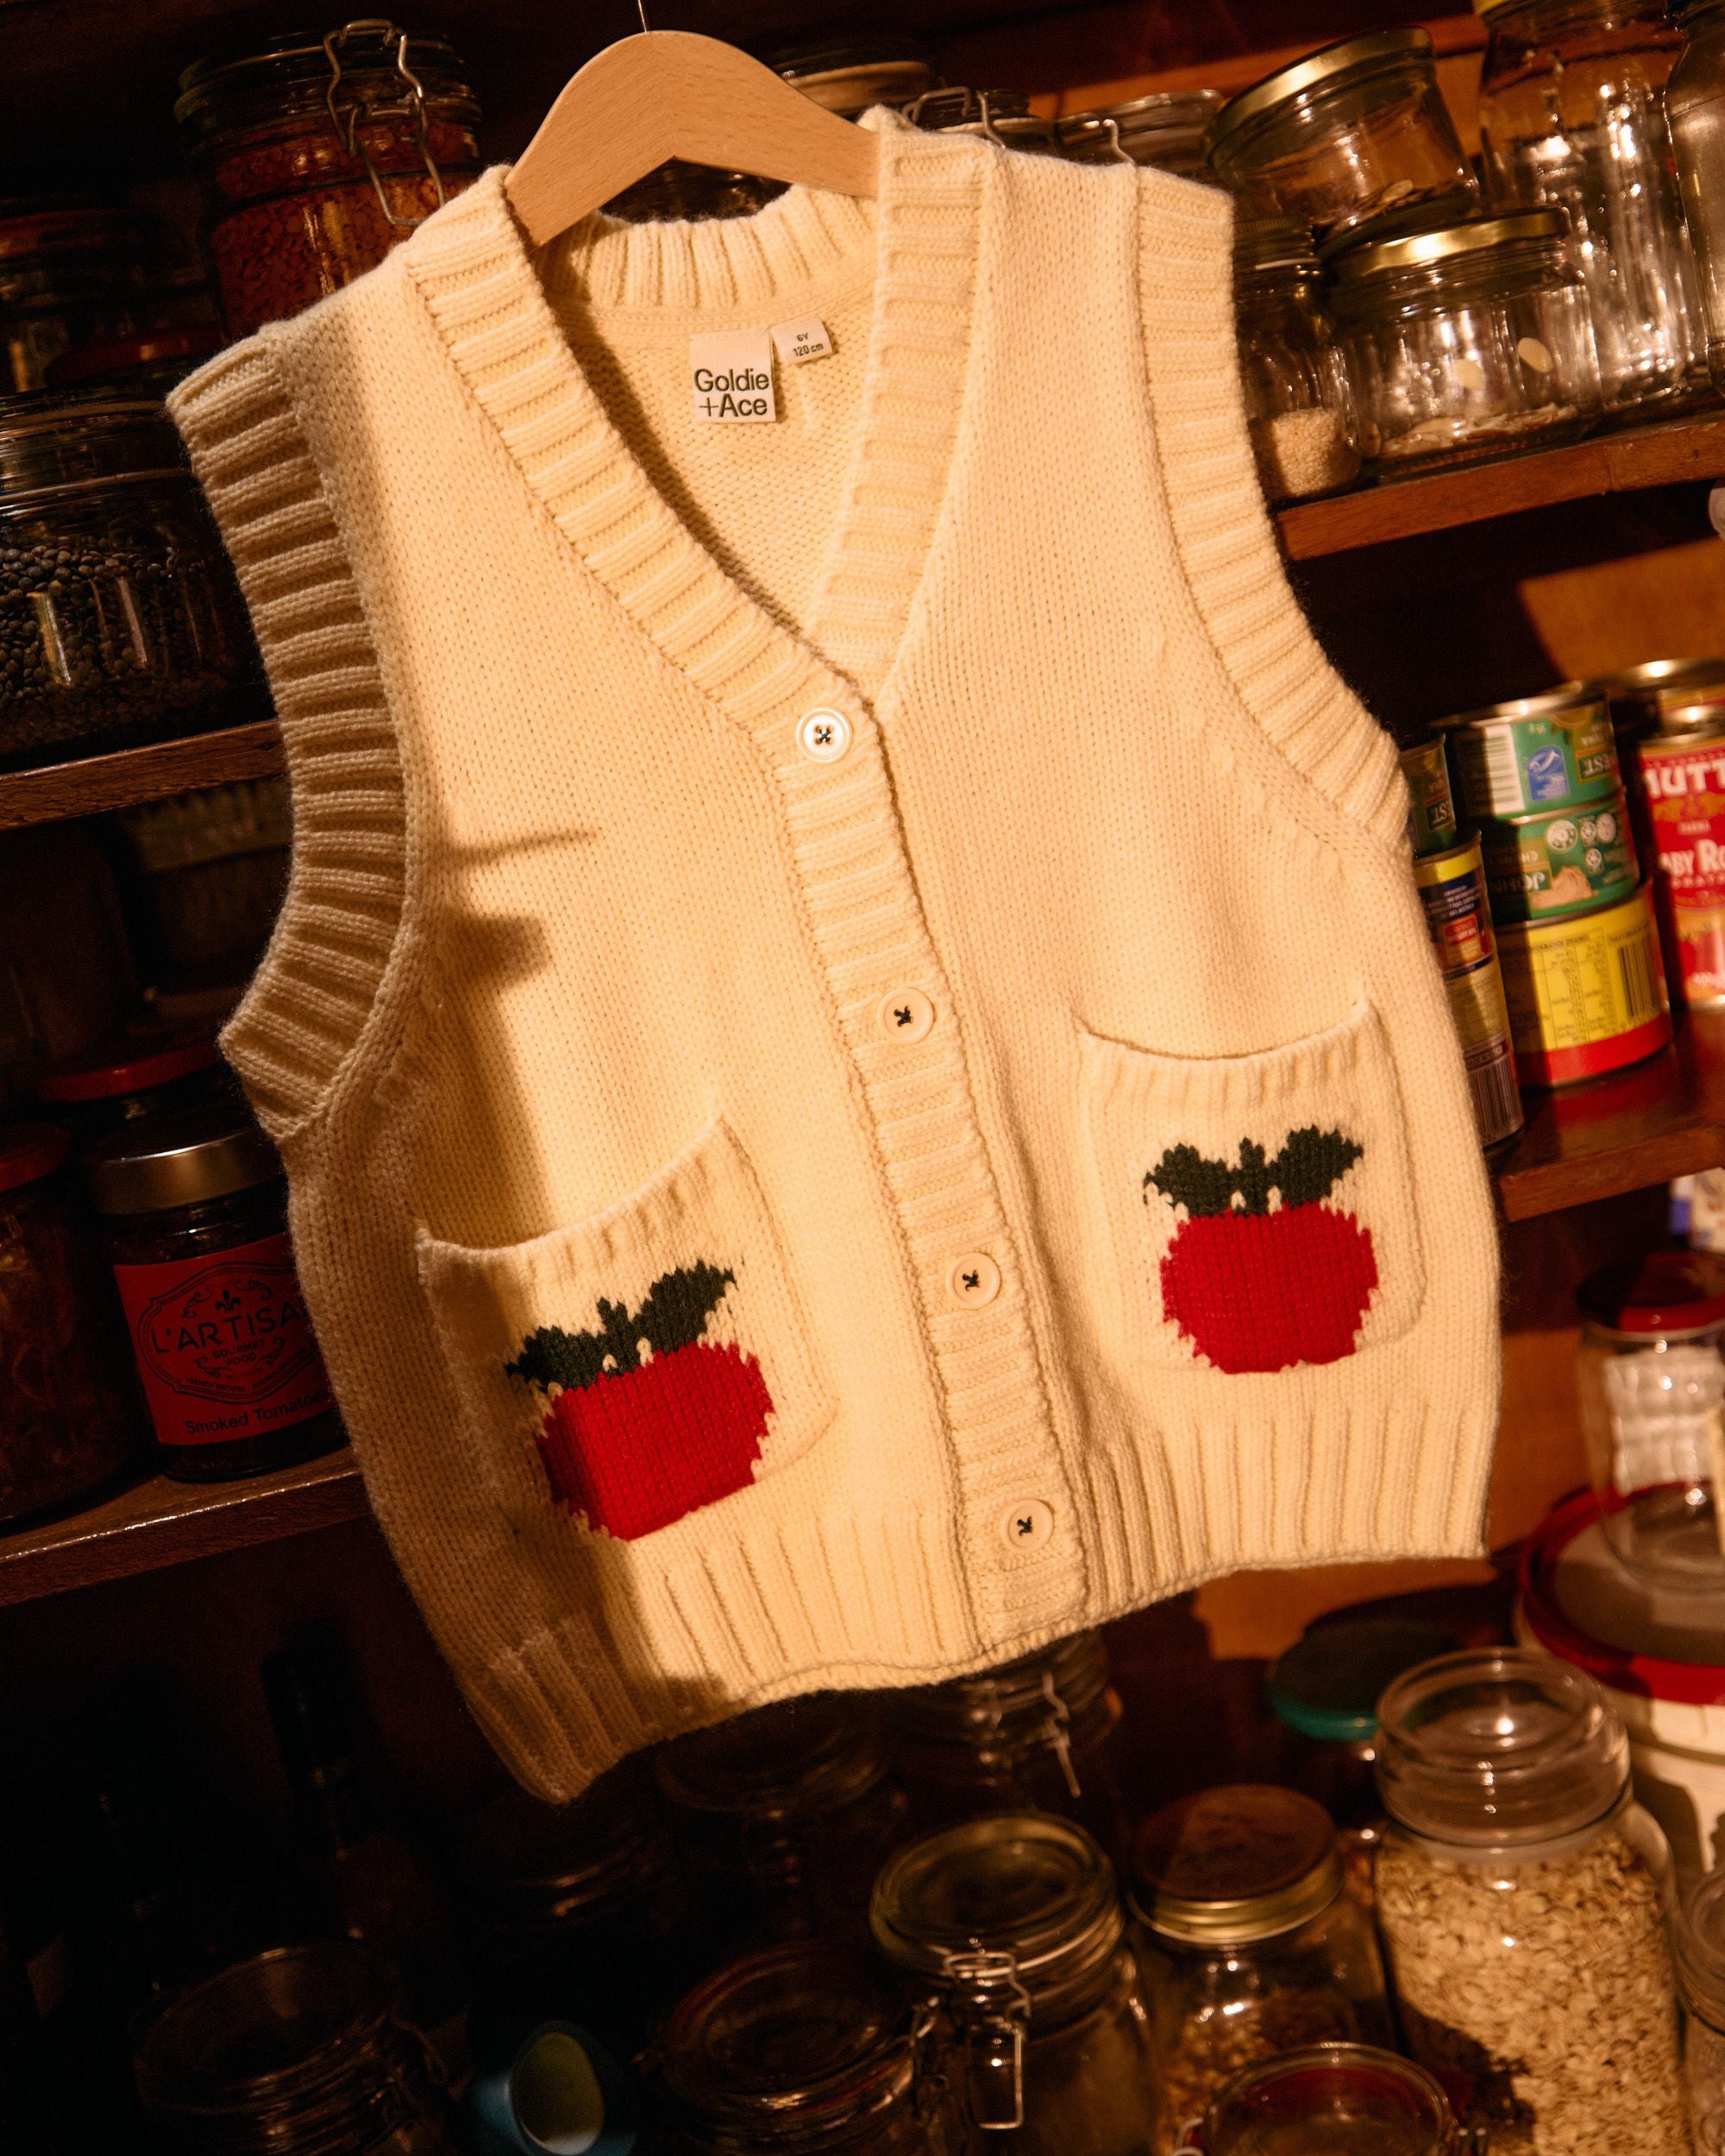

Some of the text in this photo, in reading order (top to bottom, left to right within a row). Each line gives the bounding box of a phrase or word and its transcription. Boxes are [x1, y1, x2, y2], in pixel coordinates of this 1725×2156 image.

[796, 331, 808, 342] 6Y
[794, 343, 825, 357] 120 cm
[693, 367, 770, 392] Goldie
[212, 1339, 266, 1359] GOURMET
[226, 1351, 257, 1366] FOOD
[185, 1413, 249, 1435] Smoked
